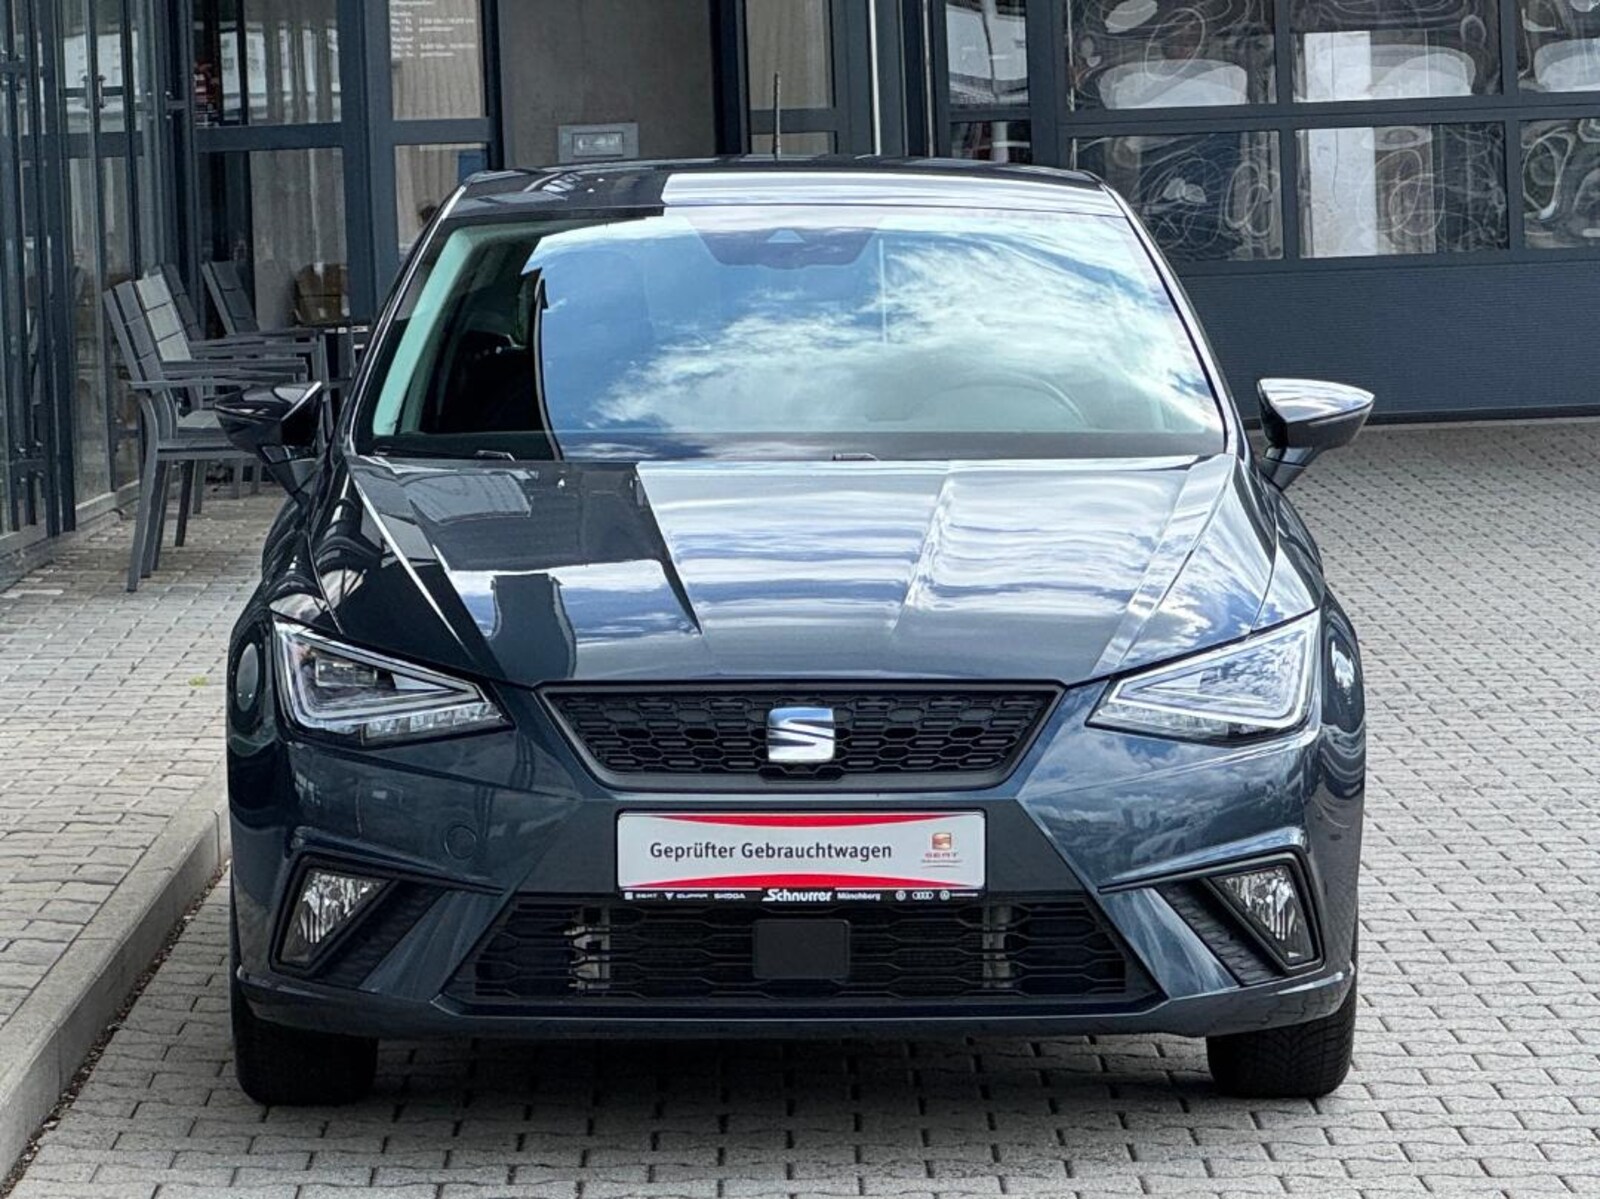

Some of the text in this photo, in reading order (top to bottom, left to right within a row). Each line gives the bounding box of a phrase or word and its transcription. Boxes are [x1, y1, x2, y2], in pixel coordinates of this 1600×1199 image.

[650, 842, 892, 862] Geprüfter Gebrauchtwagen
[761, 888, 833, 902] Schnurrer
